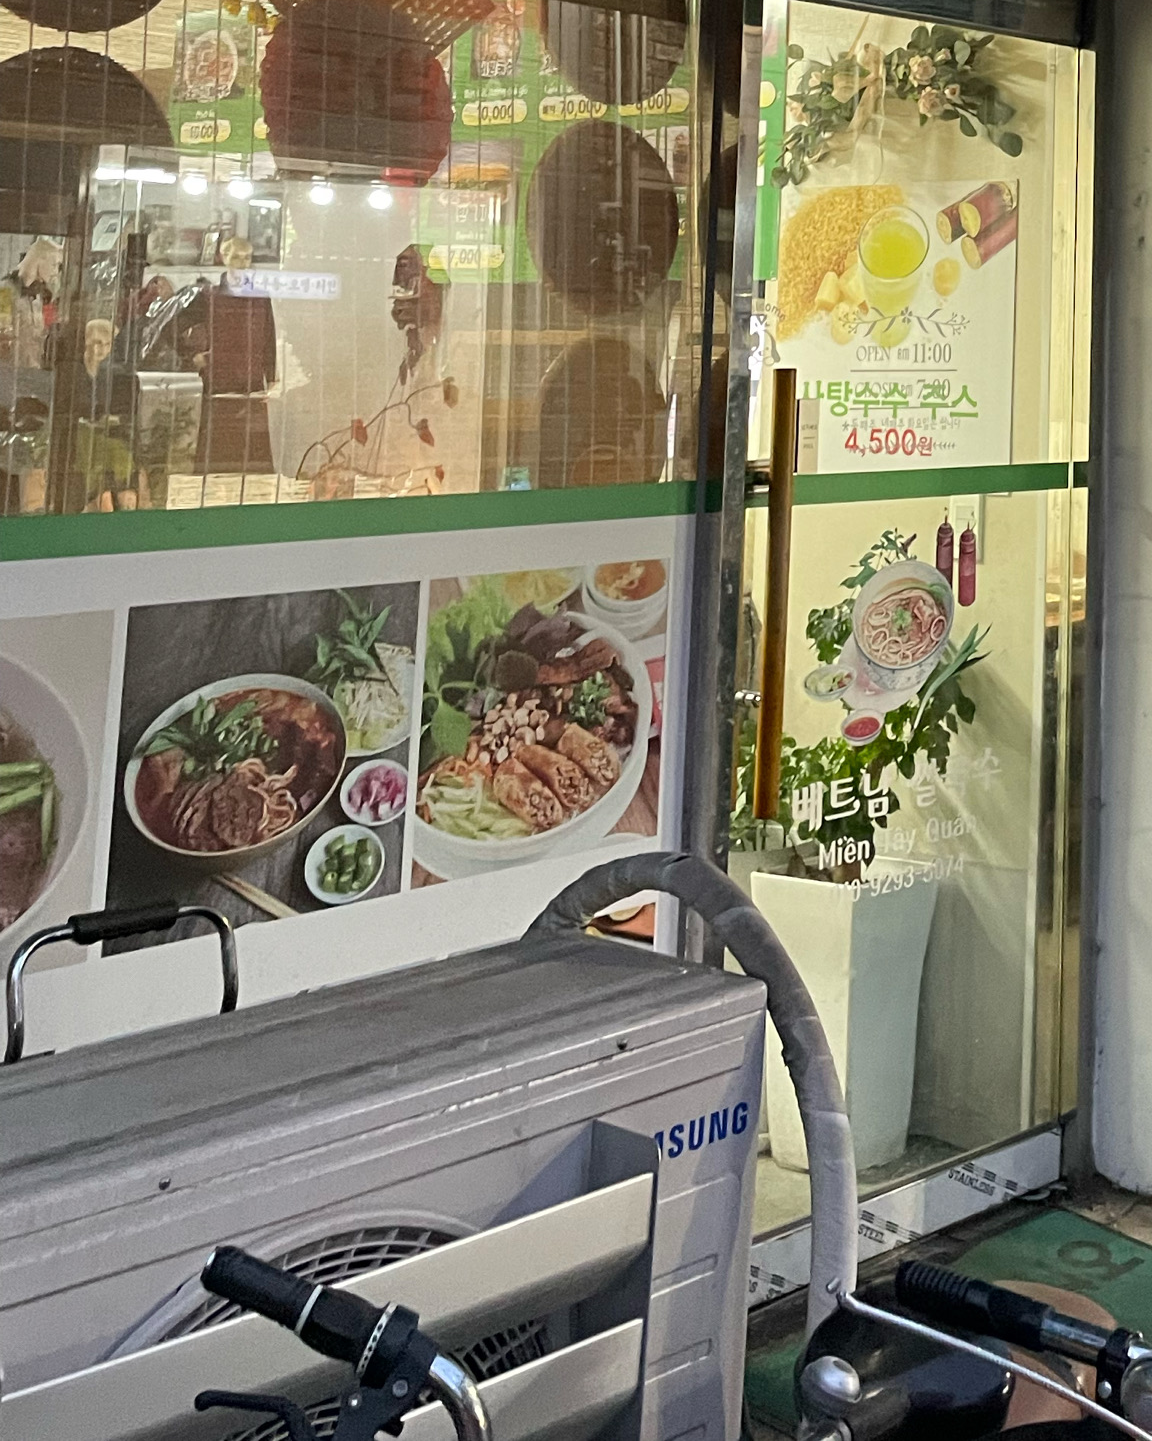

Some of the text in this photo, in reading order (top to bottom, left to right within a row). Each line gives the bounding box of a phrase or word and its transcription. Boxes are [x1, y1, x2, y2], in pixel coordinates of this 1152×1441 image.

[856, 344, 891, 362] OPEN
[913, 342, 952, 364] 11:00
[803, 379, 979, 420] 사탕수수 주스
[844, 427, 933, 458] 4,500원
[792, 768, 890, 833] 베트남
[818, 835, 871, 871] Miền
